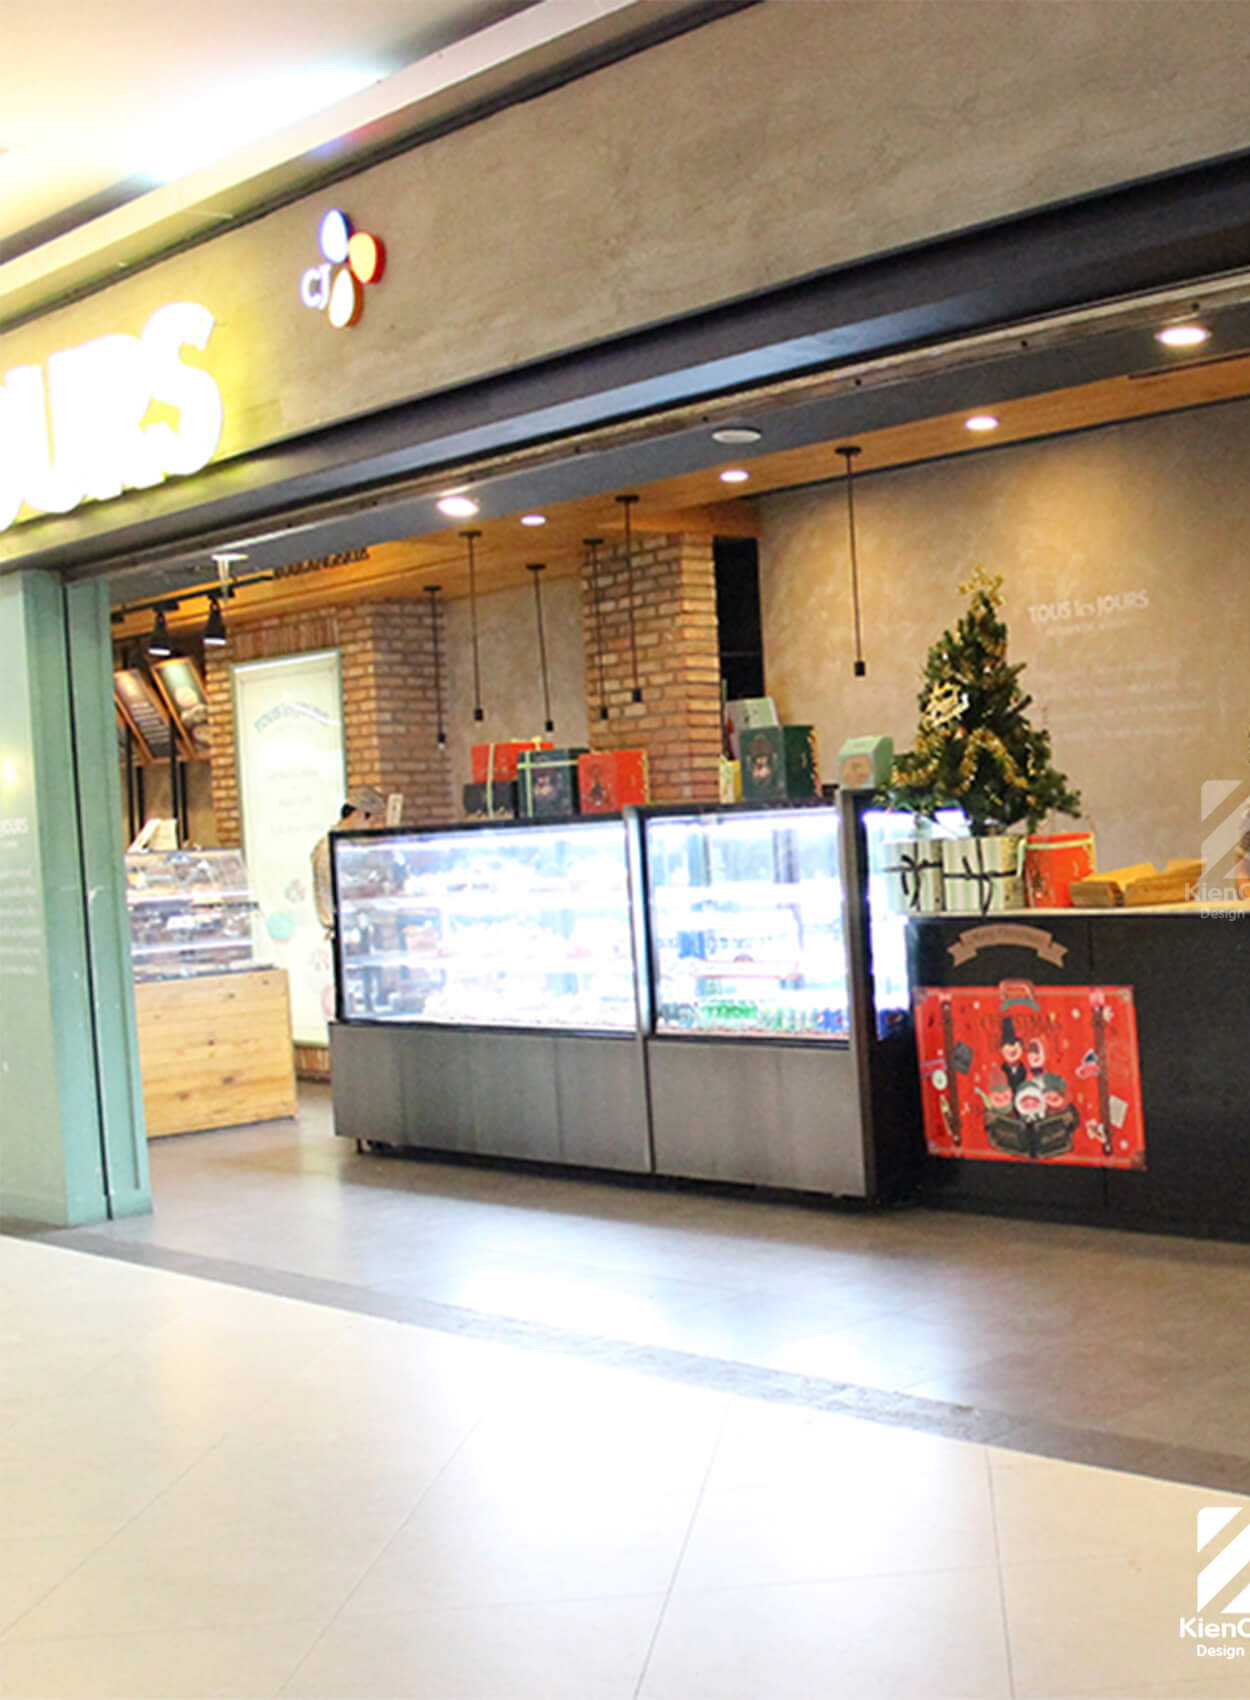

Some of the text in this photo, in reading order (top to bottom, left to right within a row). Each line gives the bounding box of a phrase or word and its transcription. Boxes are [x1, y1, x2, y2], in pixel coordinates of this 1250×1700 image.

[300, 262, 331, 310] CJ
[1028, 601, 1071, 623] TOUS
[1096, 589, 1149, 616] JOURS
